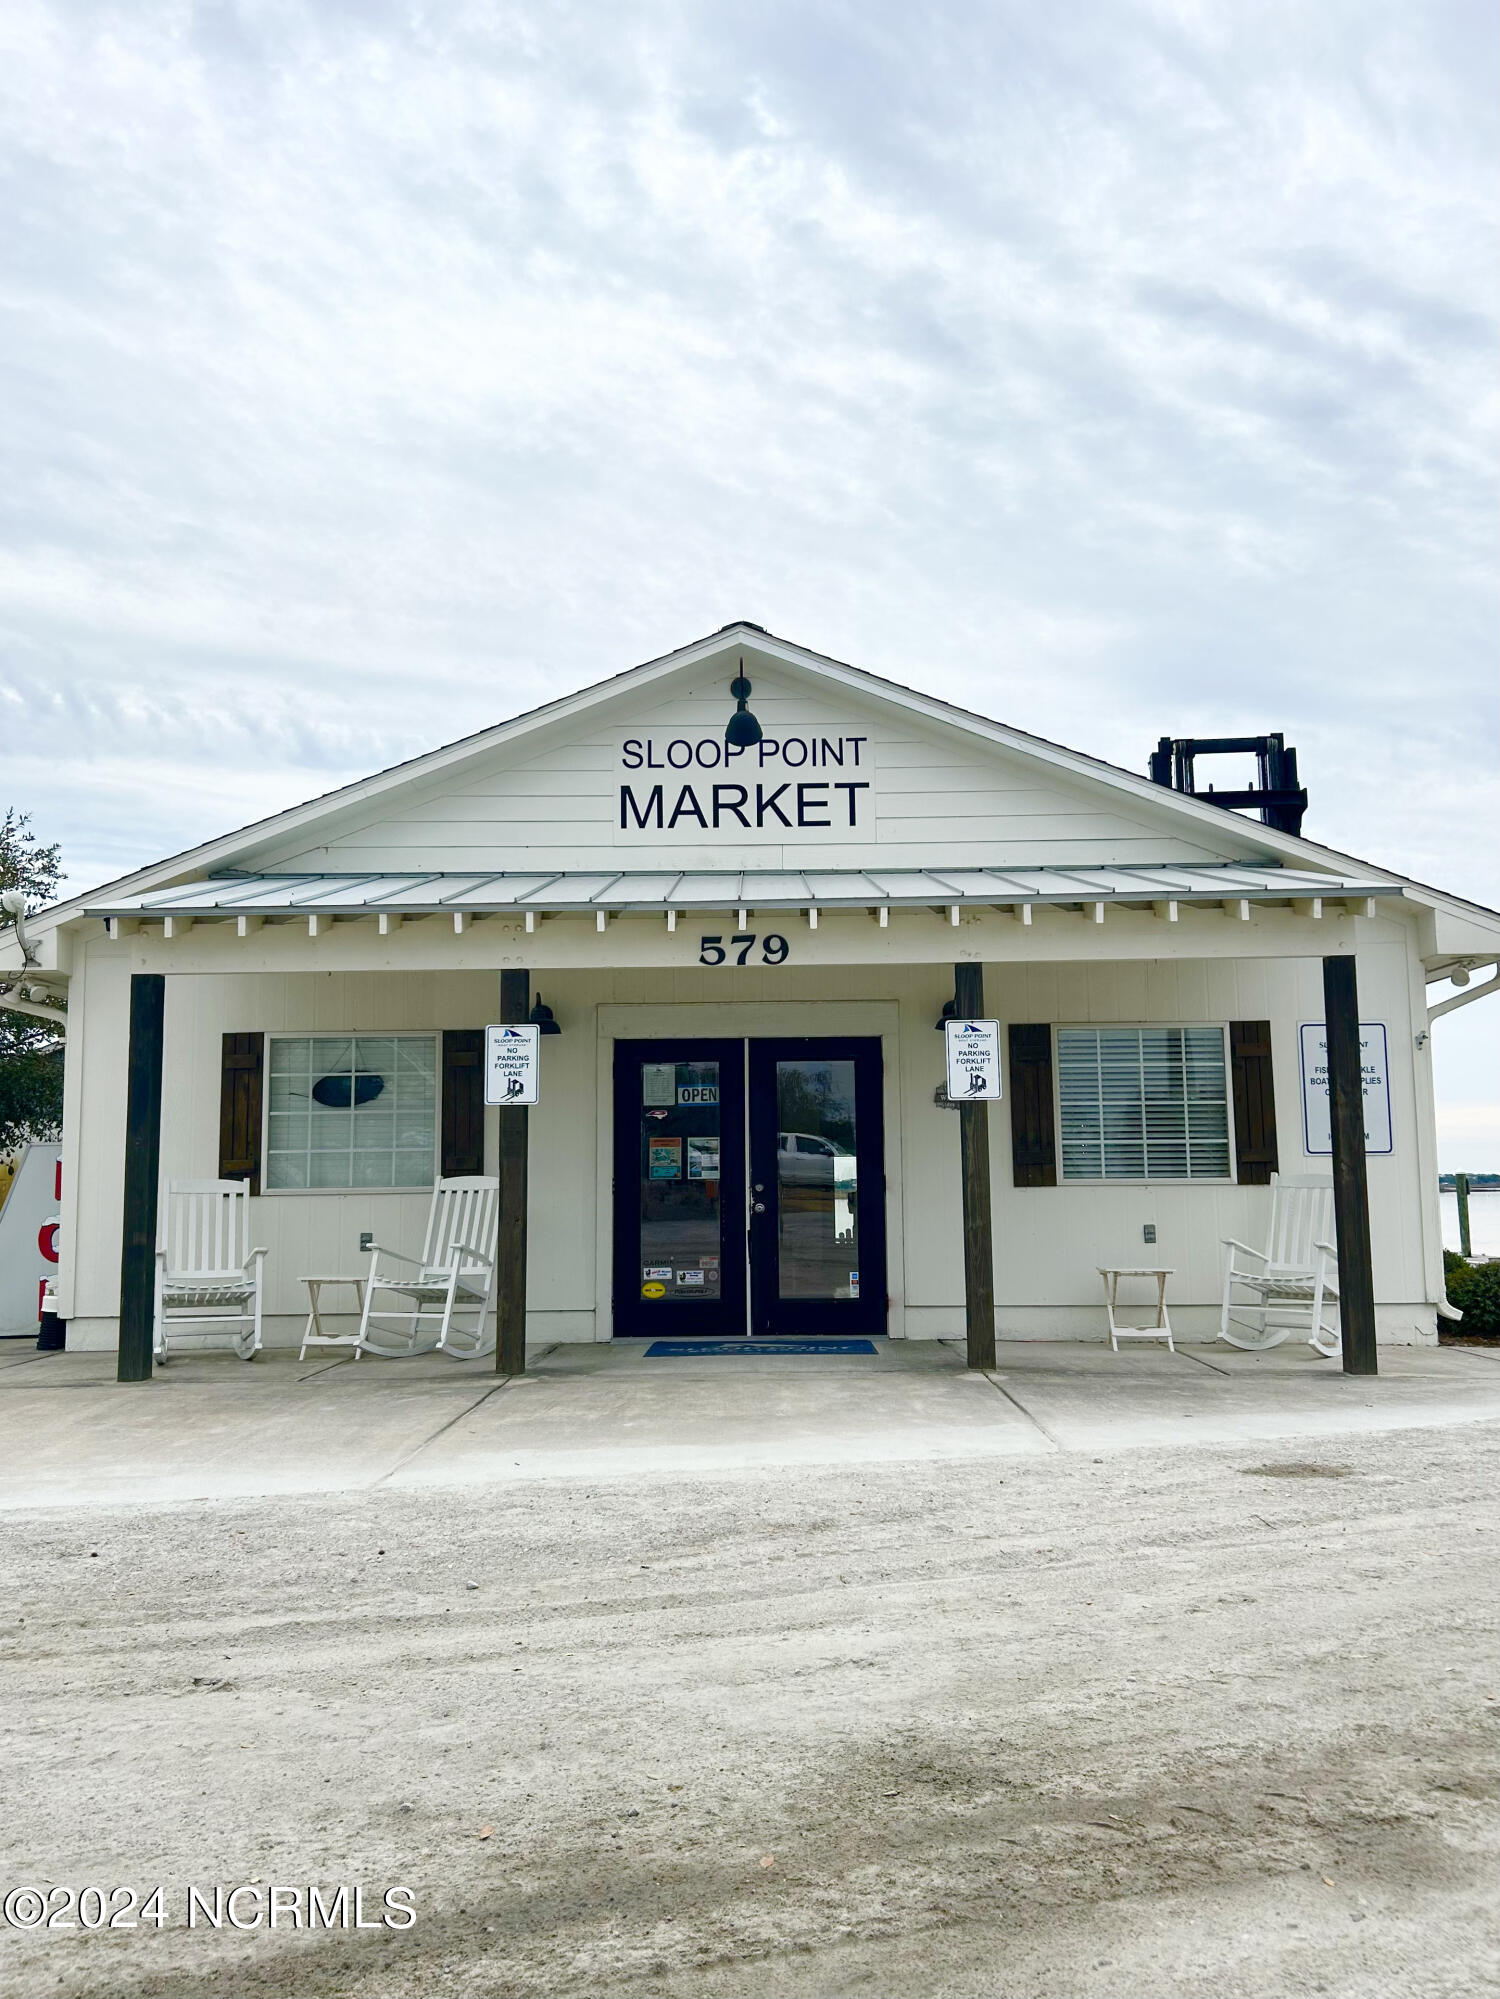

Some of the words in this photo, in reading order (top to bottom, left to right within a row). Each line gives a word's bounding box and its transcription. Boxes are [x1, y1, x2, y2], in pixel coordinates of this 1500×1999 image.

[622, 739, 745, 769] SLOOP
[759, 737, 867, 767] POINT
[620, 782, 869, 829] MARKET
[699, 934, 789, 965] 579
[682, 1087, 717, 1103] OPEN
